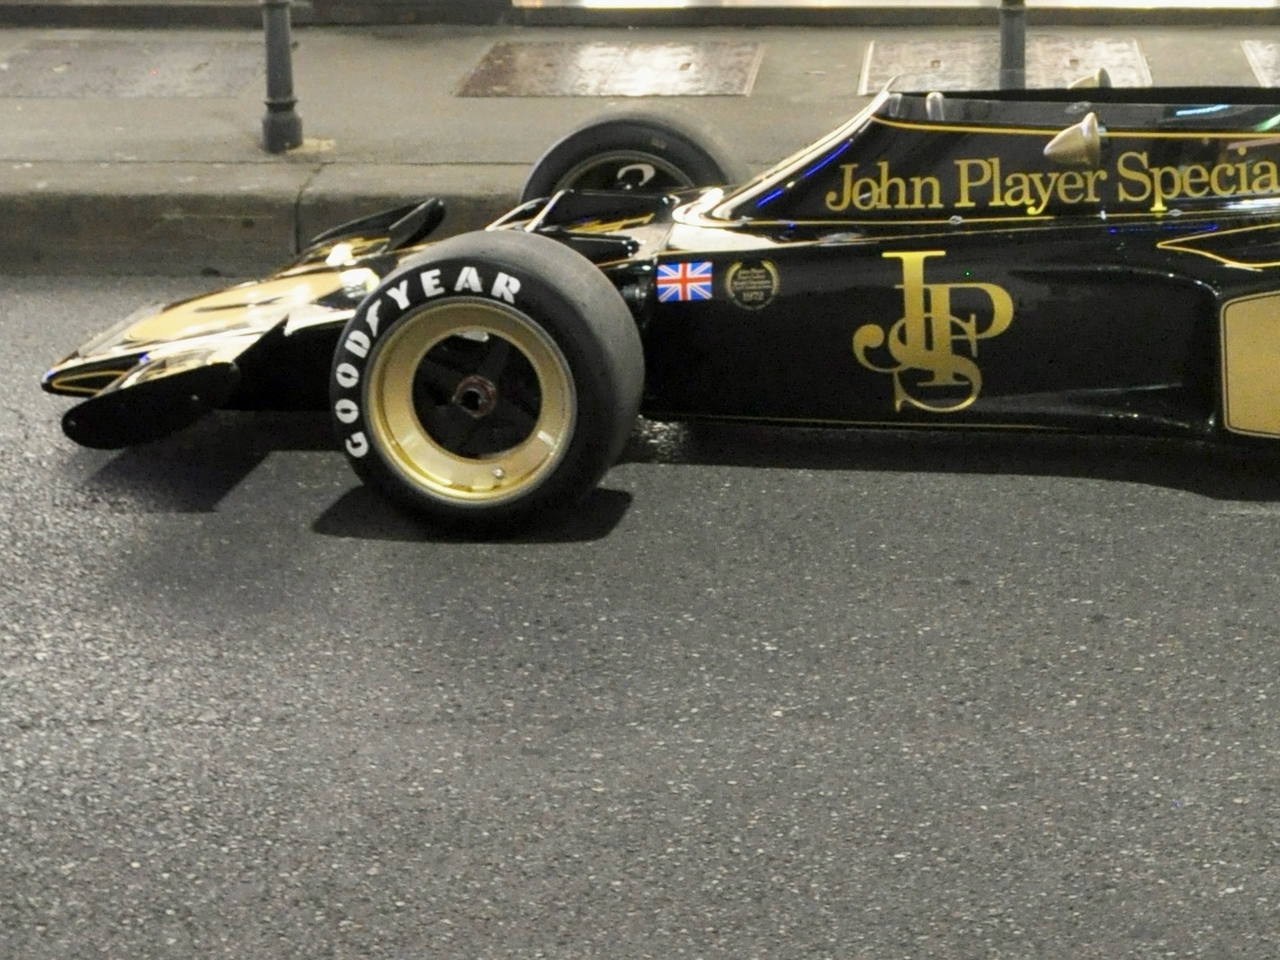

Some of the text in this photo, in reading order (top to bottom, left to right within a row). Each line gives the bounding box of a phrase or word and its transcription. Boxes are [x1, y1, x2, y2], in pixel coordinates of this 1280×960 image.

[825, 159, 943, 212] John
[953, 157, 1107, 216] Player
[335, 265, 522, 458] GOODYEAR
